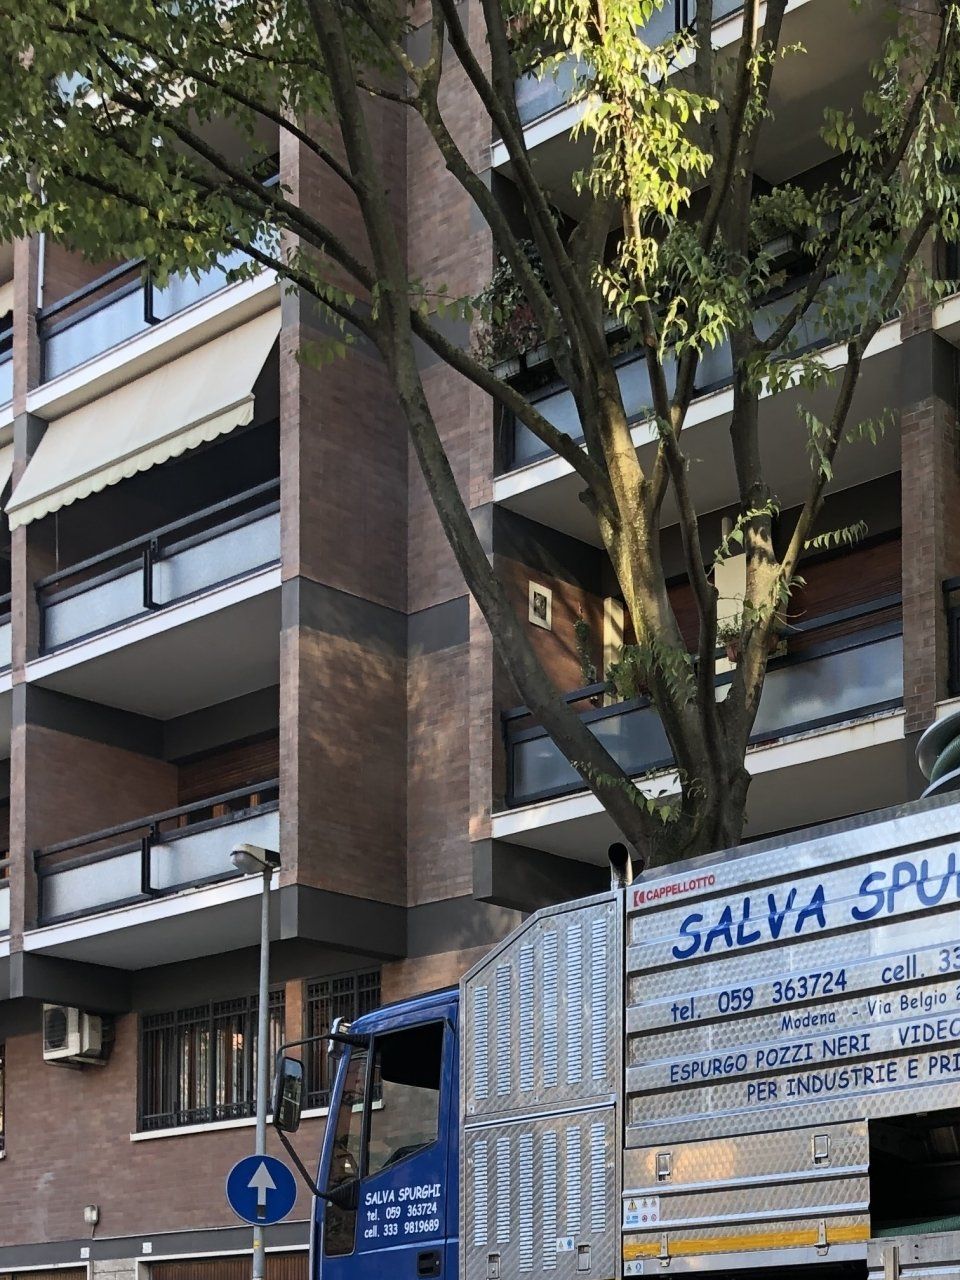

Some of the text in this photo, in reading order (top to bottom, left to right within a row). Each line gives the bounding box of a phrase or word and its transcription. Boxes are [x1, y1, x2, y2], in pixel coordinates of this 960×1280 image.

[646, 874, 716, 902] CAPPELLOTTO
[672, 884, 826, 960] SALVA
[671, 997, 702, 1023] tel.
[718, 986, 754, 1014] 059
[772, 968, 848, 1004] 363724
[881, 954, 925, 984] cell.
[781, 1010, 836, 1032] Modena
[867, 1000, 892, 1017] Via
[901, 990, 947, 1012] Belgio
[670, 1053, 748, 1084] ESPURGO
[756, 1042, 814, 1069] POZZI
[822, 1032, 871, 1059] NERI
[747, 1080, 778, 1102] PER
[786, 1061, 898, 1096] INDUSTRIE
[907, 1057, 919, 1080] E
[364, 1183, 441, 1206] SALVA SPURGHI
[367, 1201, 438, 1222] tel. 059 363724
[364, 1218, 440, 1238] cell. 333 9819689
